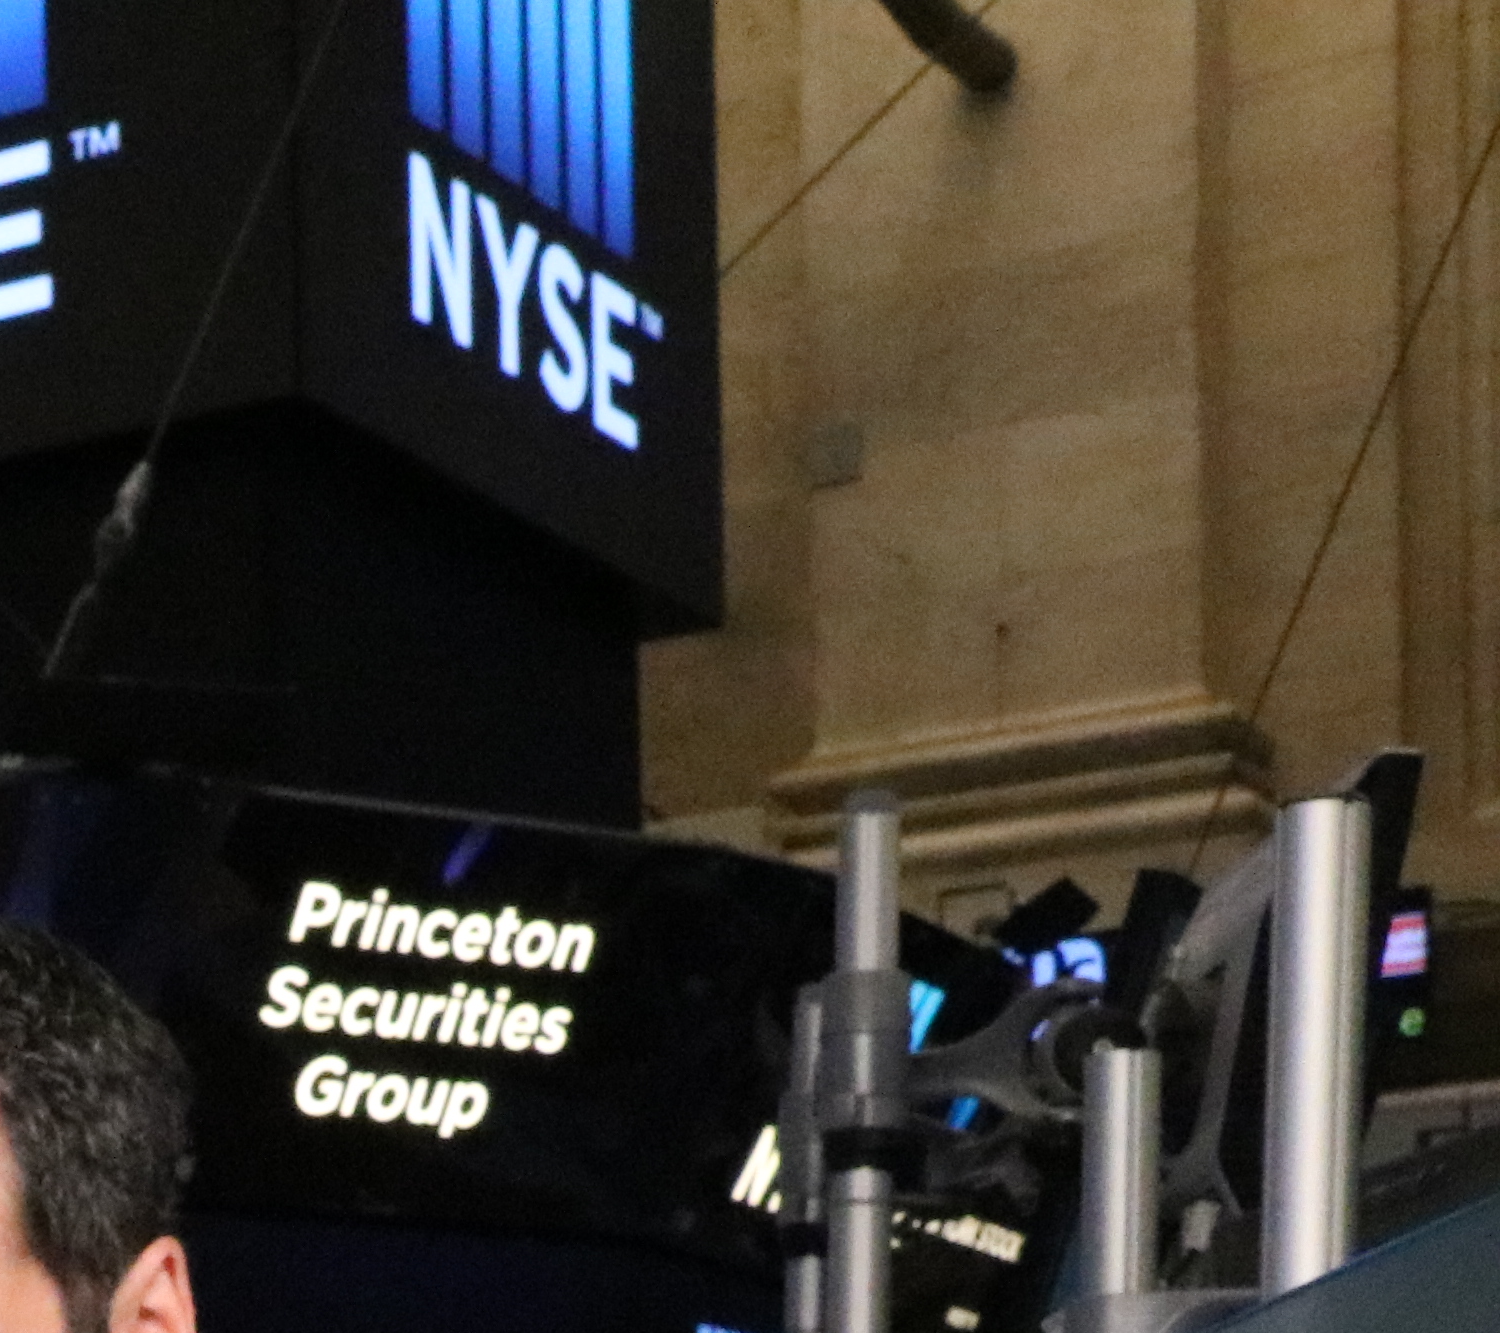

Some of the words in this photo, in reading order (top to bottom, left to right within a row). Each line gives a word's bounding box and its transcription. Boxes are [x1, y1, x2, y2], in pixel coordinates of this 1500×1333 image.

[407, 150, 639, 450] NYSE
[288, 880, 596, 973] Princeton
[258, 965, 574, 1056] Securities
[294, 1053, 490, 1139] Group
